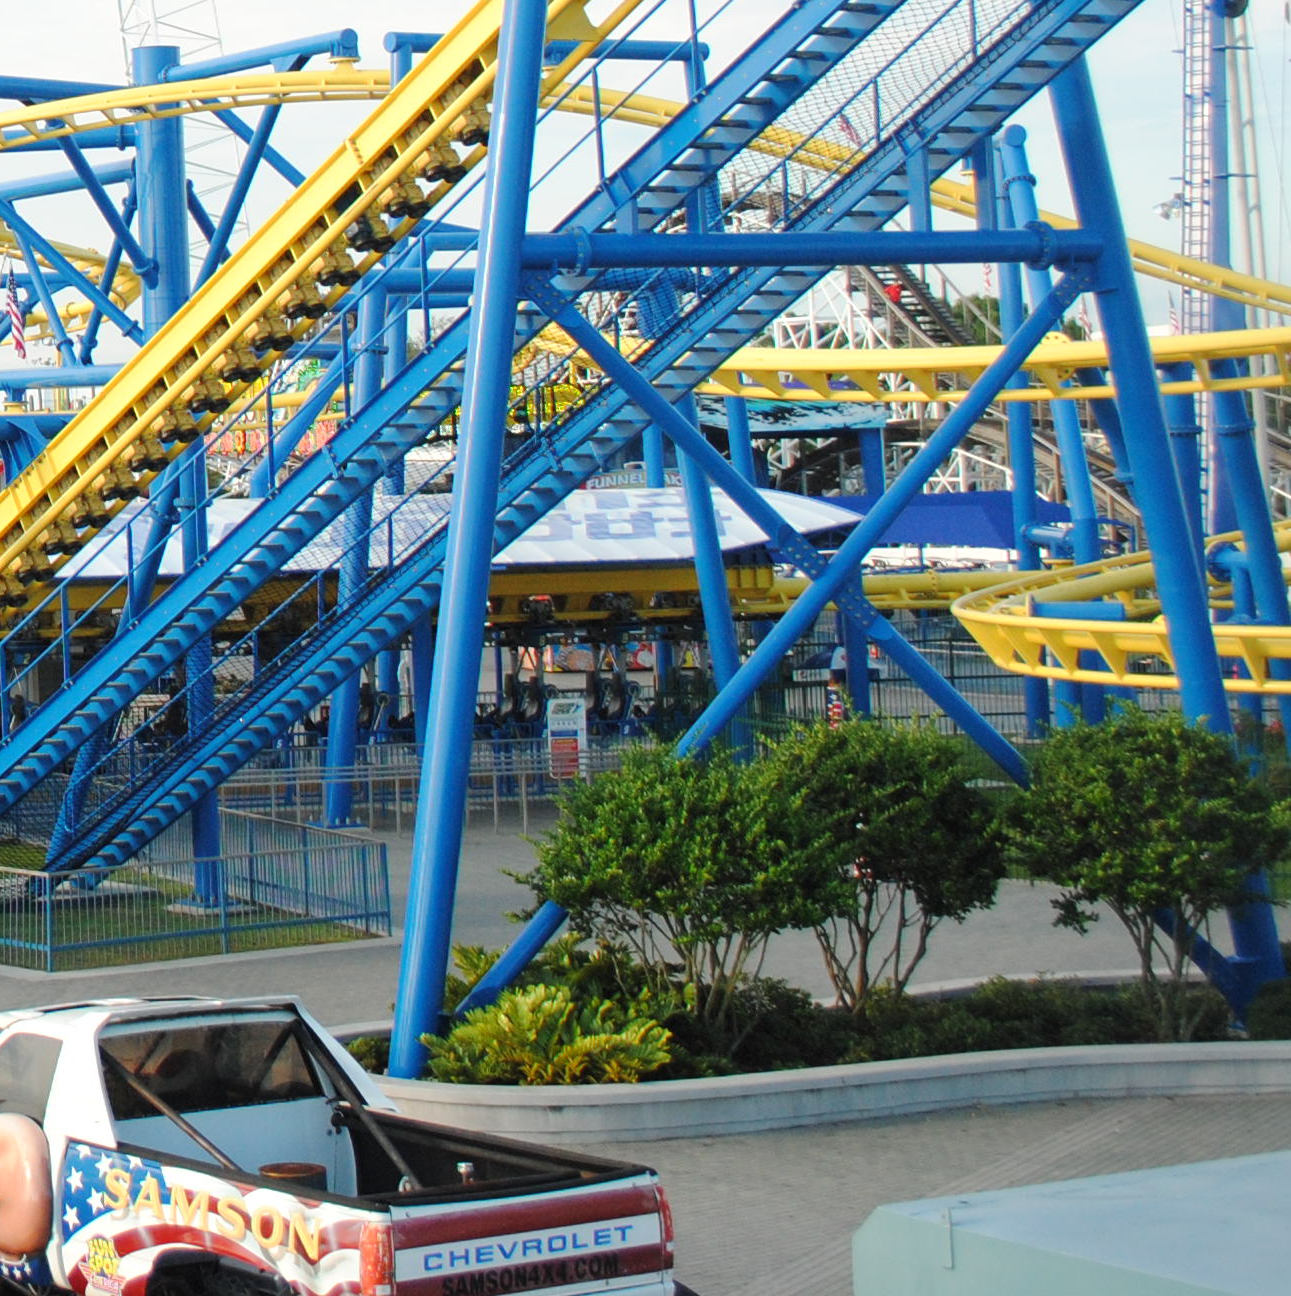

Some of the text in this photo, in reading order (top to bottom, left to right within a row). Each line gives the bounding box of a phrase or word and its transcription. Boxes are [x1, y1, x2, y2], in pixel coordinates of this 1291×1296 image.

[586, 471, 645, 490] FUNNEL
[103, 1167, 322, 1262] SAMSON
[88, 1237, 116, 1259] FUN
[423, 1224, 634, 1272] CHEVROLET
[88, 1255, 120, 1275] SPOT
[442, 1254, 619, 1296] SAMSON4X4.COM
